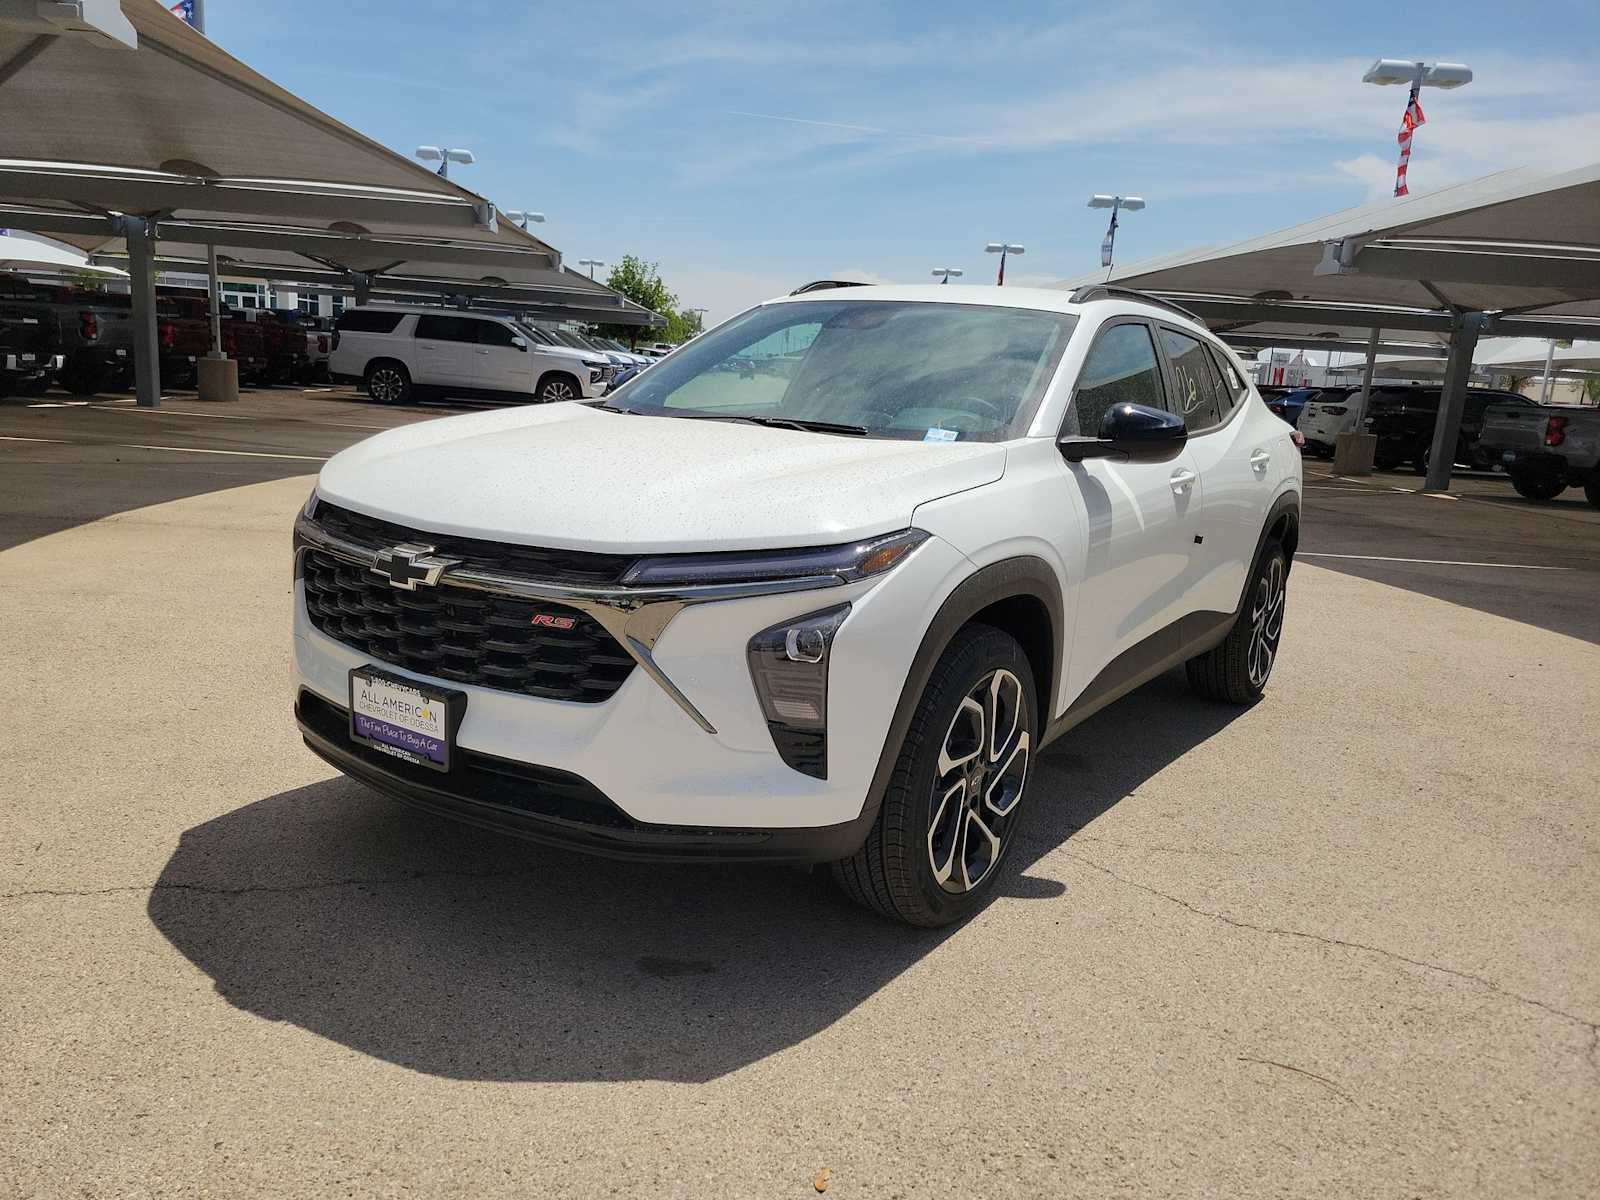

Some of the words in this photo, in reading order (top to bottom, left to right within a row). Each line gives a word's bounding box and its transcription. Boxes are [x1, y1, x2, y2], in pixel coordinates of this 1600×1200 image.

[531, 614, 575, 629] RS
[361, 689, 380, 705] ALL
[359, 701, 397, 720] CHEVROLET
[399, 714, 409, 724] OF
[410, 718, 439, 734] ODESSA
[360, 717, 370, 729] The
[382, 724, 398, 738] Place
[398, 731, 406, 741] To
[407, 734, 420, 748] Buy
[420, 738, 426, 748] A
[426, 740, 438, 751] Car
